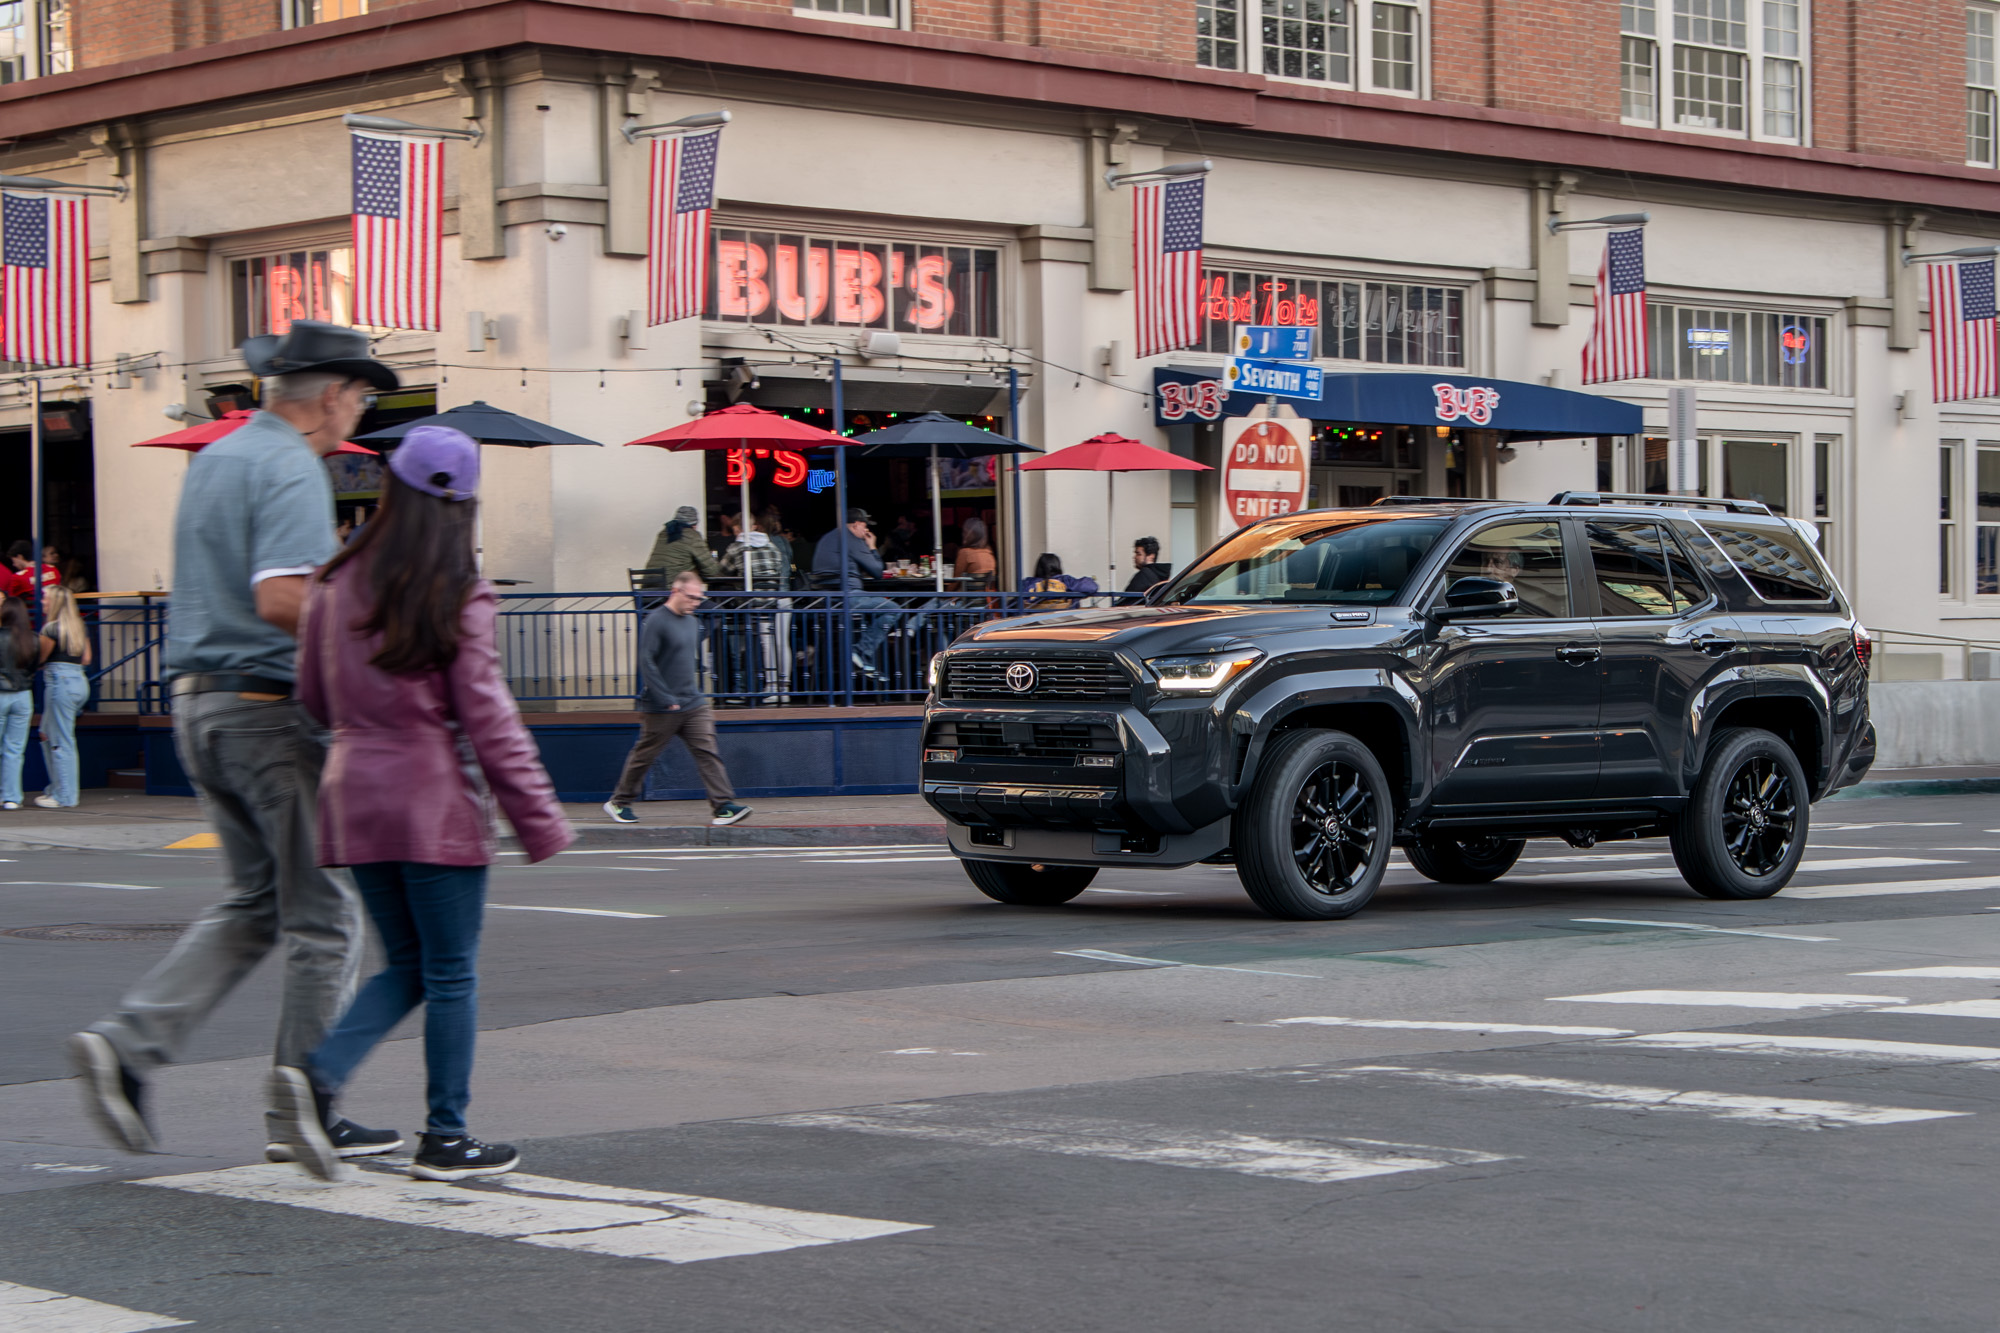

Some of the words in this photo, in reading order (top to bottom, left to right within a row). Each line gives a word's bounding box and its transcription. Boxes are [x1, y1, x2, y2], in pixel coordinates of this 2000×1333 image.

[719, 240, 955, 329] BUB'S
[1259, 331, 1270, 354] J
[1235, 443, 1260, 463] DO
[1264, 444, 1298, 464] NOT
[807, 469, 836, 494] Lite
[1236, 497, 1291, 518] ENTER
